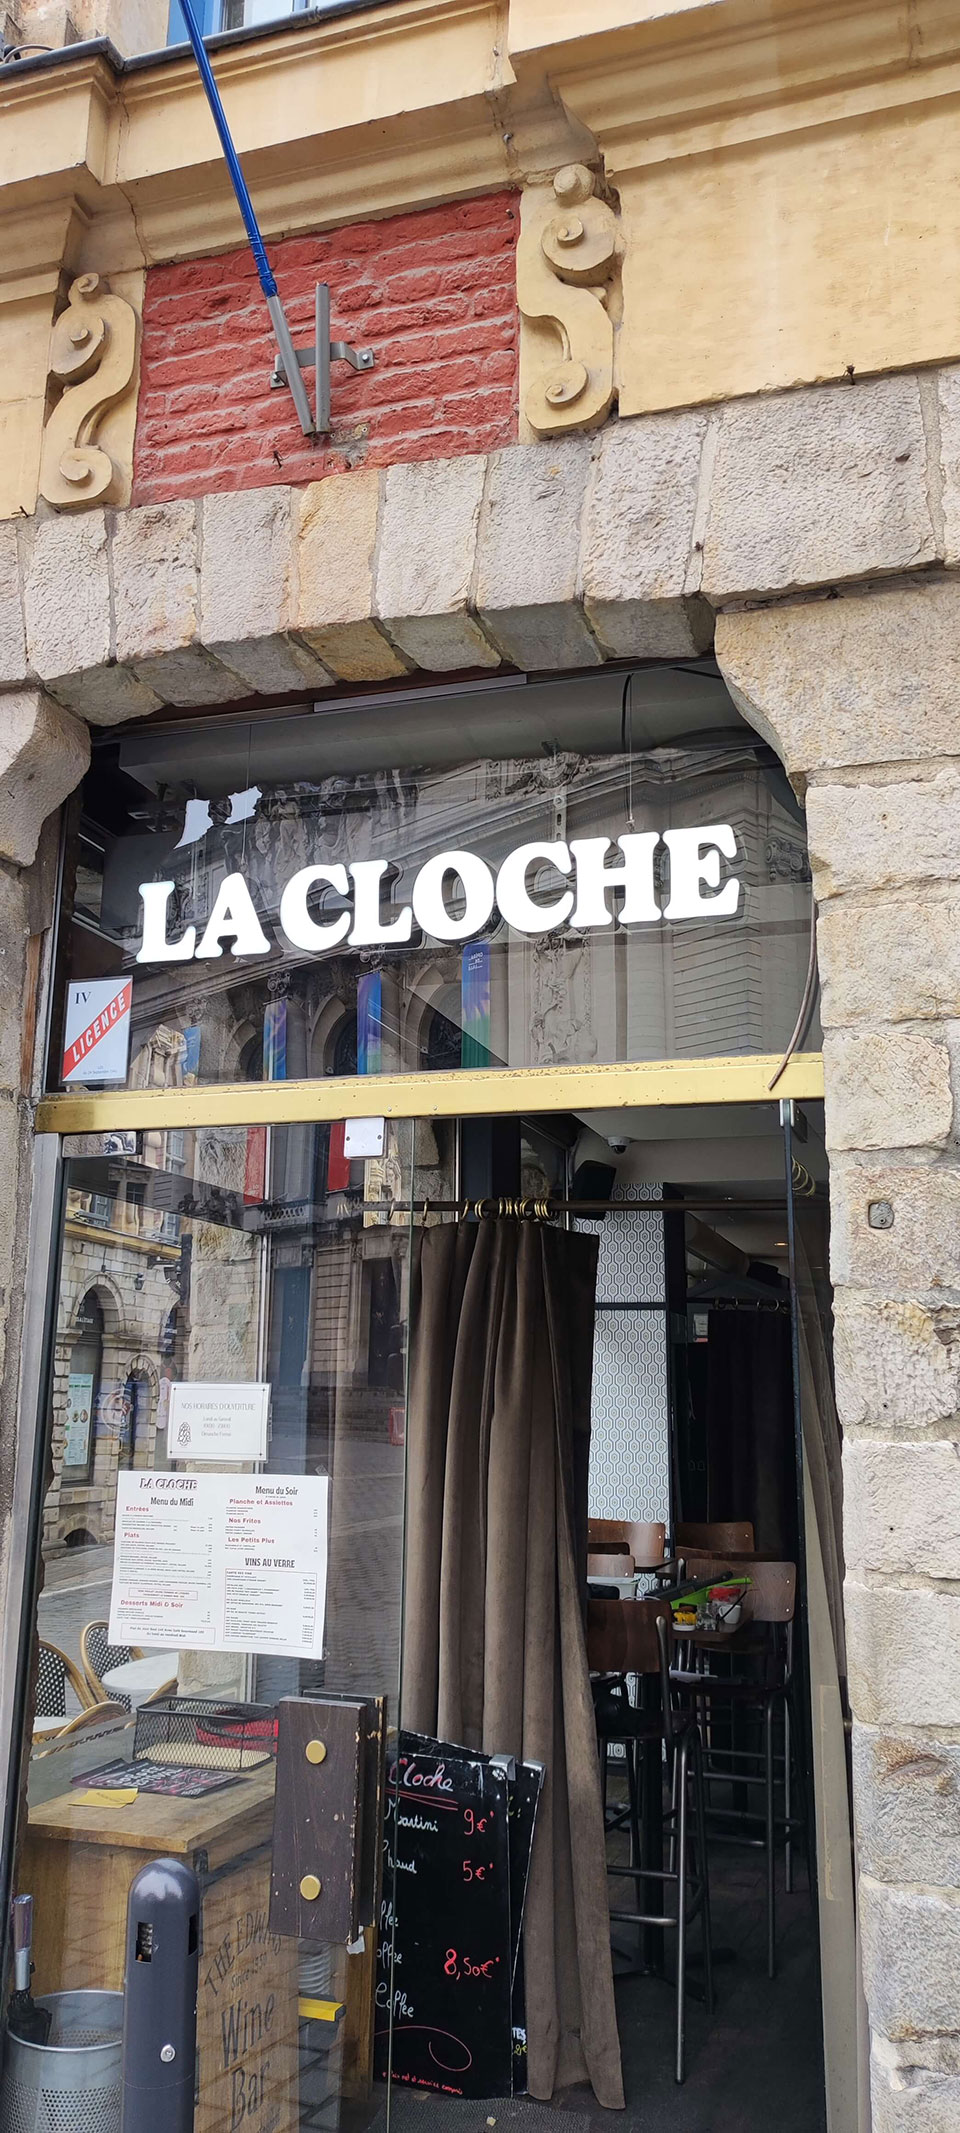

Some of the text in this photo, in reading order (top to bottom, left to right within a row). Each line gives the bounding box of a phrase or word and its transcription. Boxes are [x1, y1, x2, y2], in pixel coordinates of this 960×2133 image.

[136, 824, 742, 964] LA CLOCHE
[75, 991, 91, 1005] IV
[72, 992, 126, 1063] LICENCE
[181, 1402, 192, 1410] NOS
[193, 1402, 219, 1410] HORAIRES
[140, 1478, 198, 1490] LA CLOCHE
[255, 1486, 298, 1495] Menu du Soir
[150, 1497, 194, 1506] Menu du Midi
[245, 1557, 295, 1568] VINS AU VERRE
[388, 1758, 454, 1792] Cloche
[204, 1931, 235, 1998] THE
[376, 1941, 403, 1969] offee
[221, 1993, 275, 2069] Wine
[230, 2061, 270, 2133] Bar
